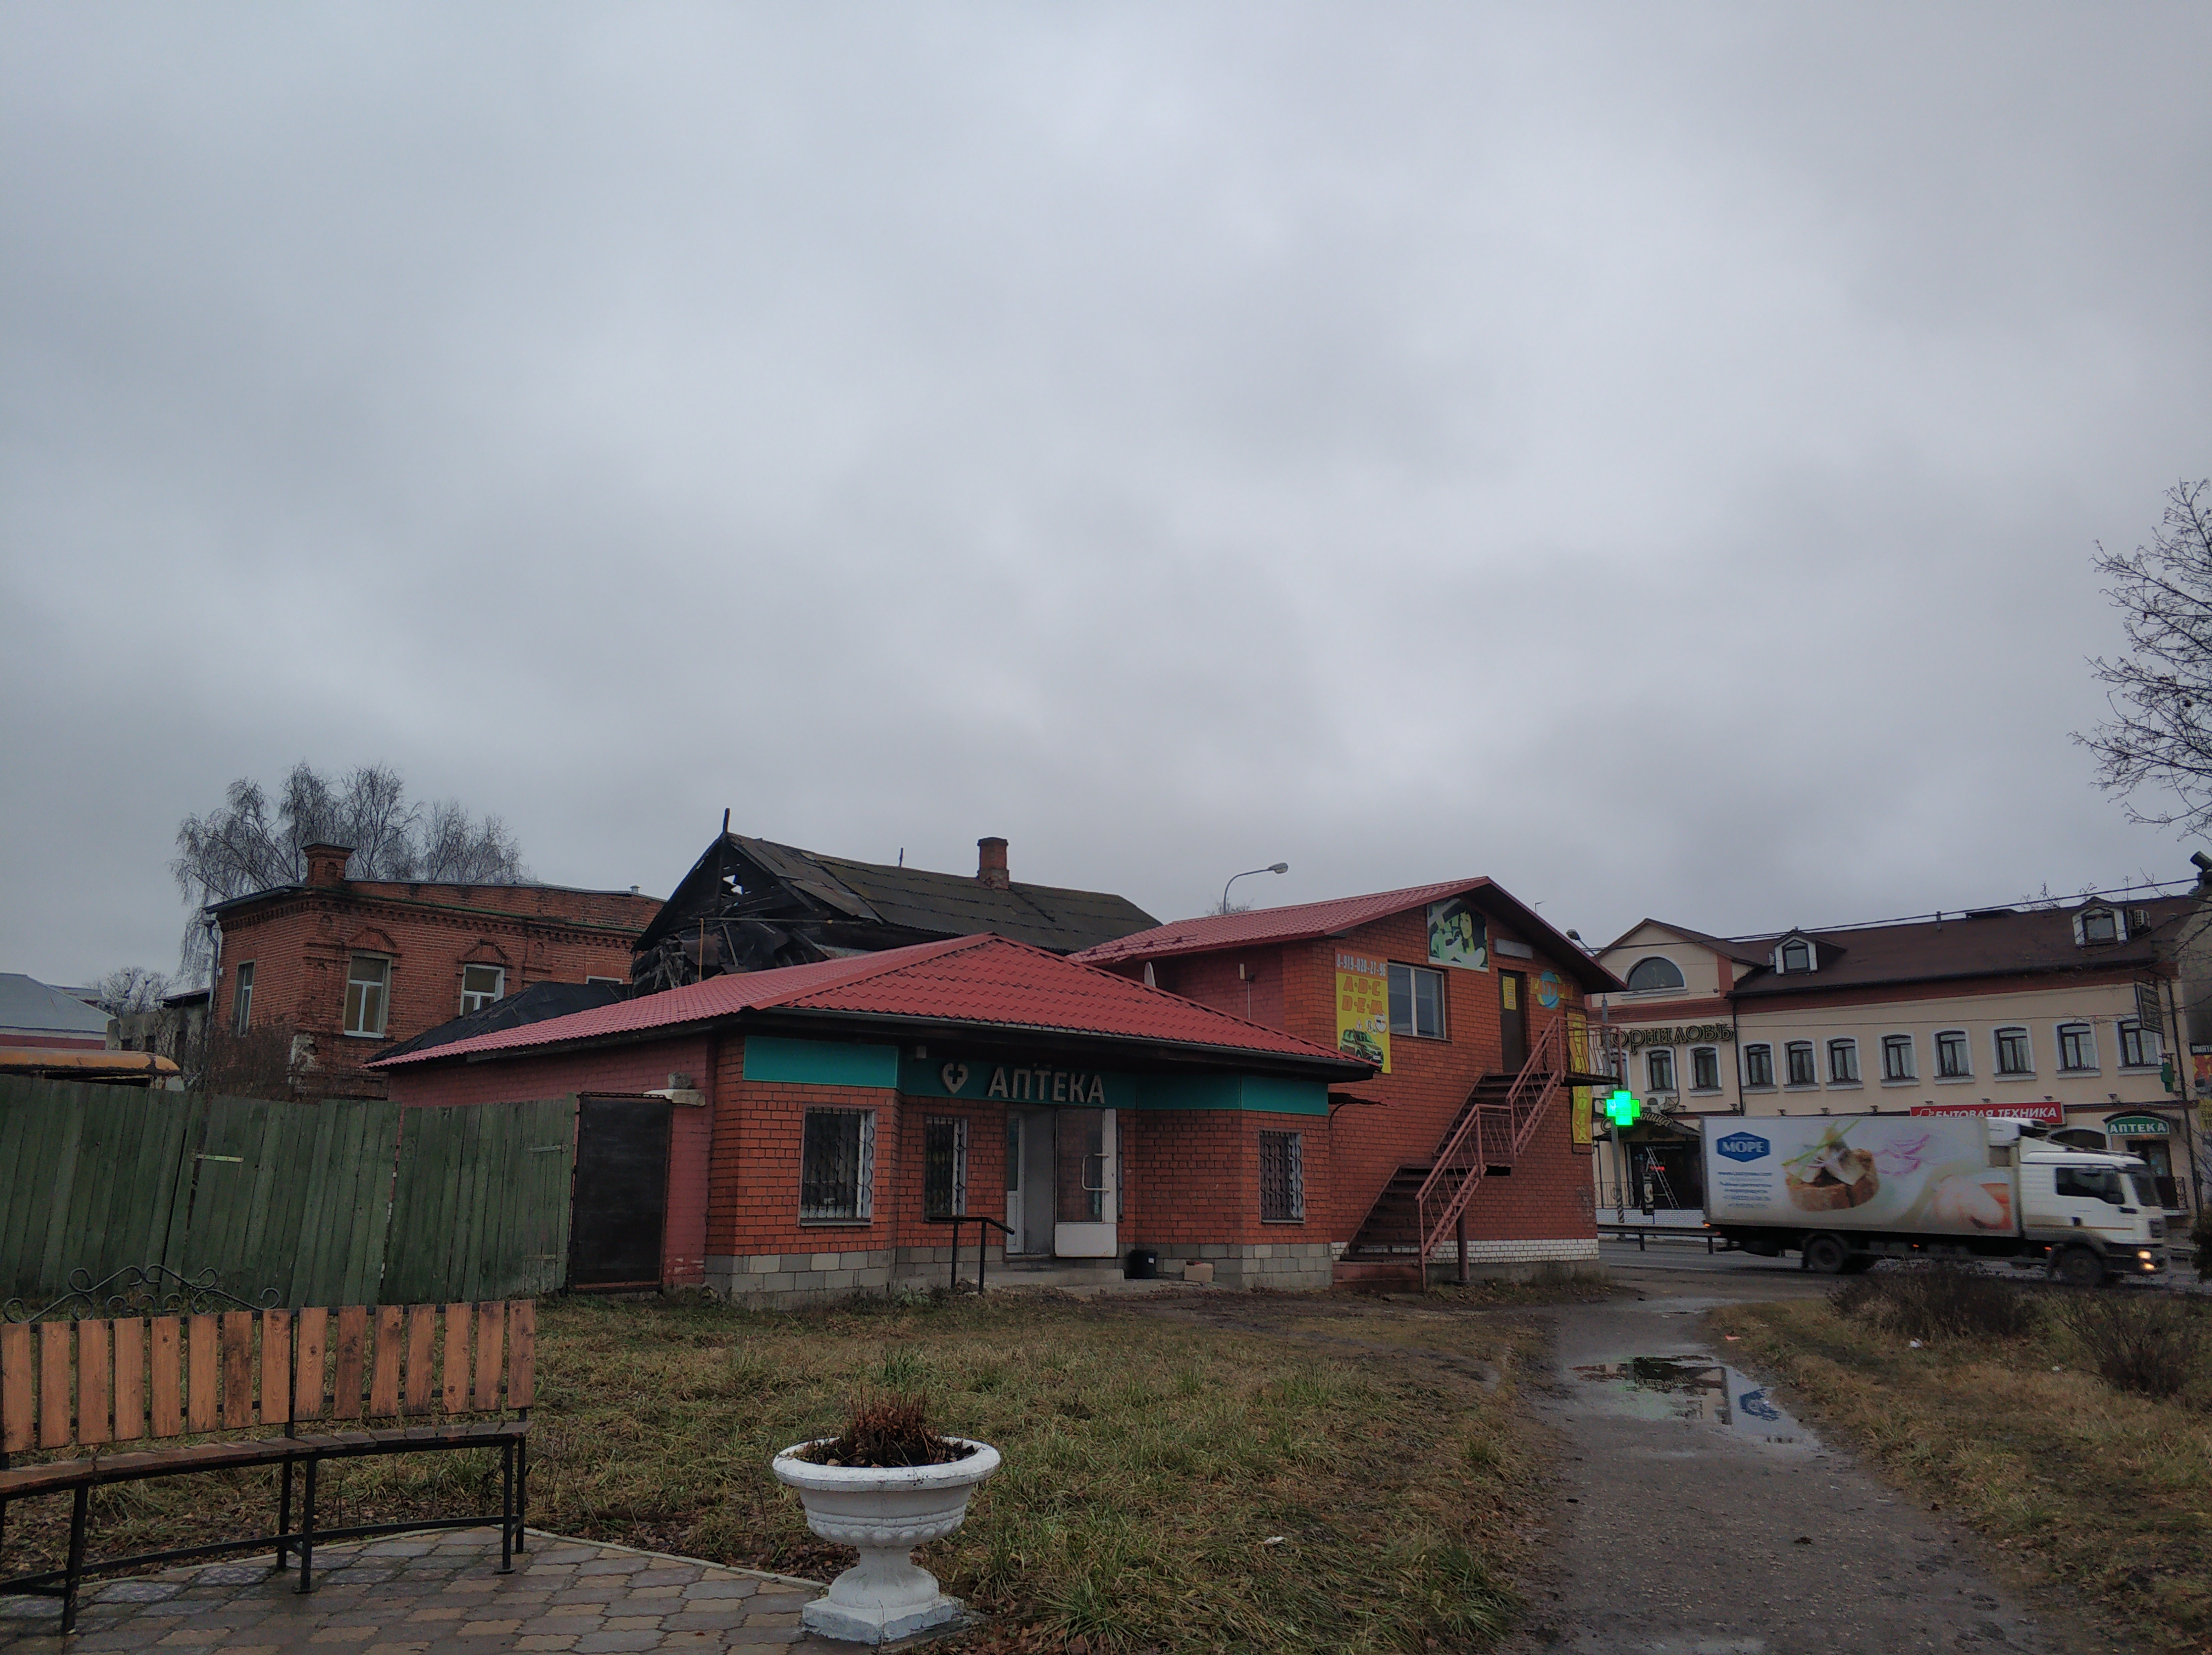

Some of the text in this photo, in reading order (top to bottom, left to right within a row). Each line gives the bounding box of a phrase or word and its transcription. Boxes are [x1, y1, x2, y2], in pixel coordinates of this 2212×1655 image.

[988, 1067, 1105, 1104] АПТЕКА
[1997, 1107, 2057, 1118] ТЕХНИКА
[2109, 1122, 2166, 1133] АПТЕКА
[1722, 1141, 1765, 1153] МОРЕ
